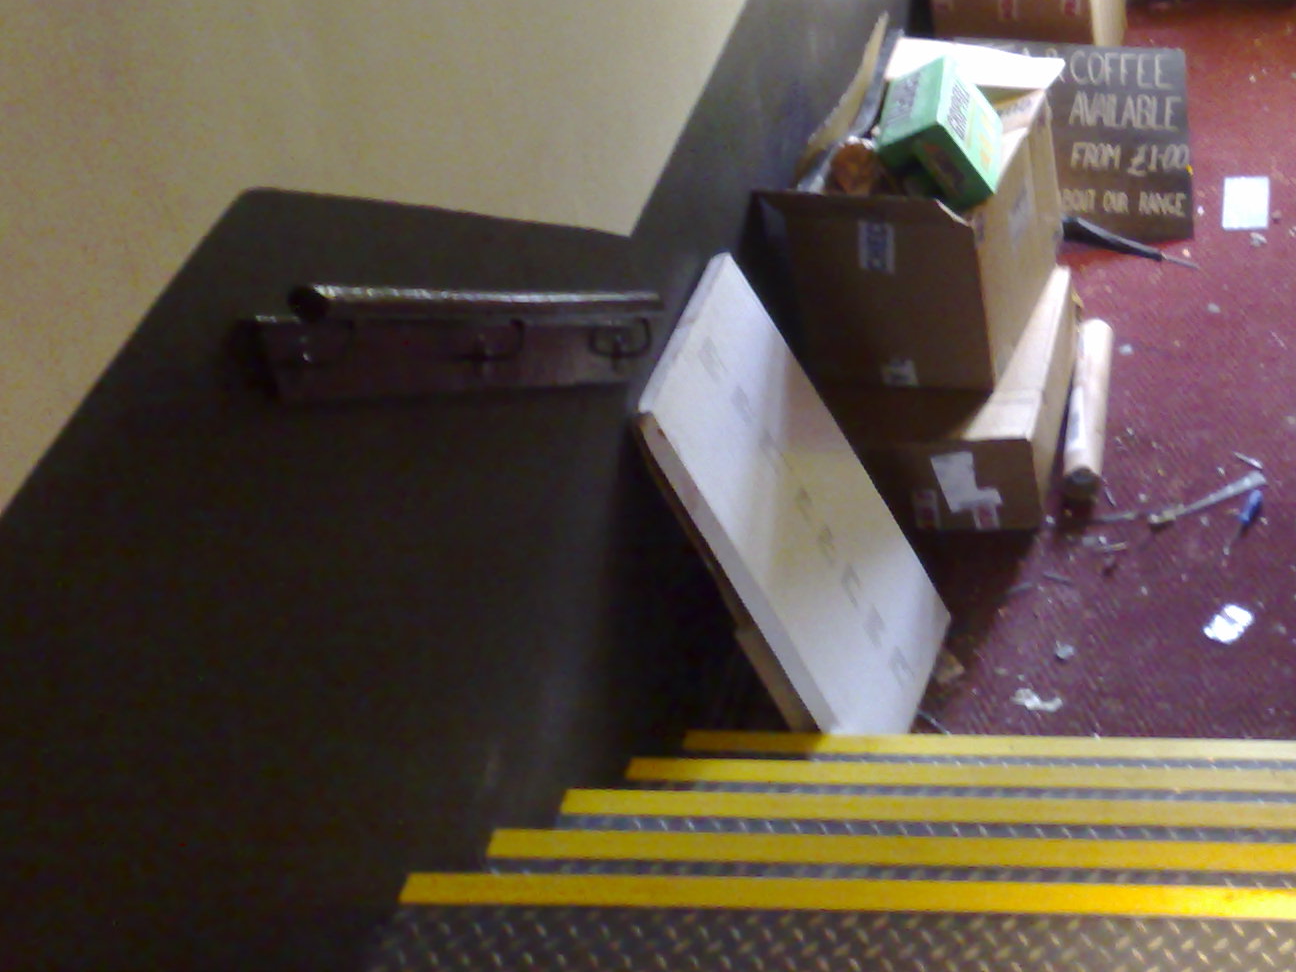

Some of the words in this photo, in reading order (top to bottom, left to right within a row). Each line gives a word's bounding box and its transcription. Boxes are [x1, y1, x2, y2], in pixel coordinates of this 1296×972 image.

[1069, 49, 1174, 91] COFFEE
[1069, 92, 1183, 132] AVAILABLE
[1070, 141, 1121, 172] FROM
[1060, 188, 1096, 214] BOUT
